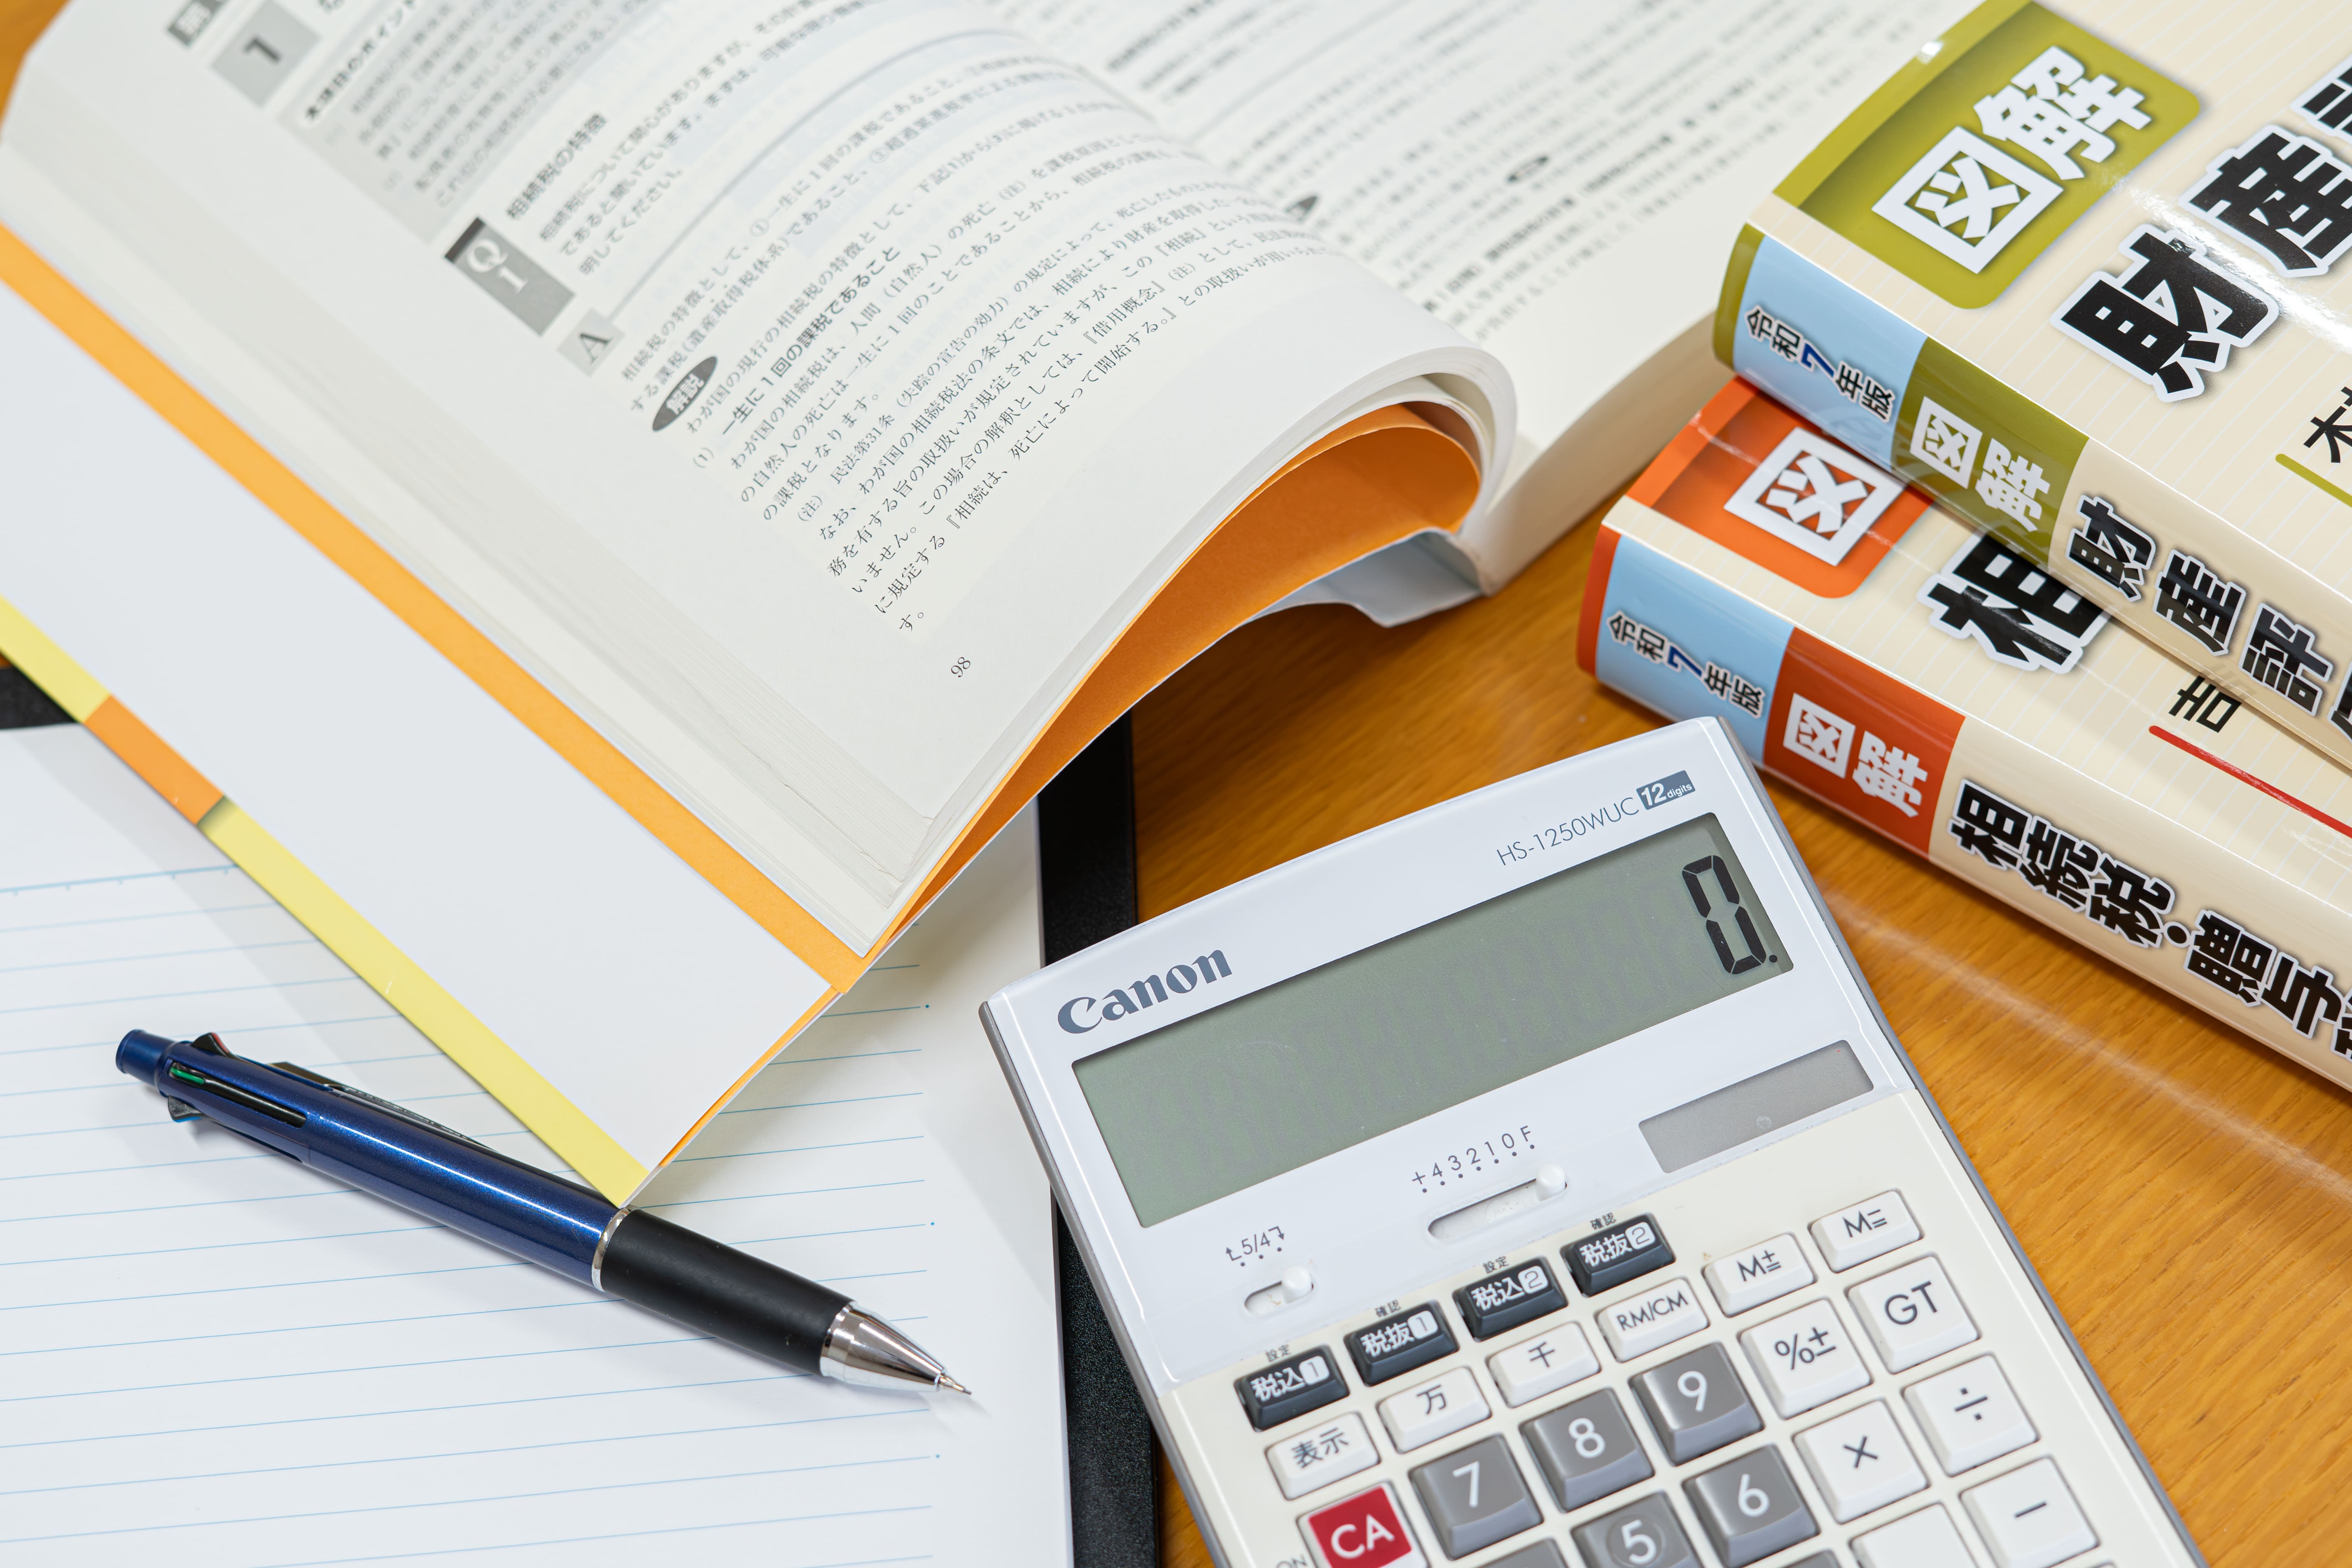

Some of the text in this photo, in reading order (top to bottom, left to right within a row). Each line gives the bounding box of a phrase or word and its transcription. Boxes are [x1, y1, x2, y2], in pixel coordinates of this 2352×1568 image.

[1871, 46, 2151, 273] 図解
[2059, 56, 2352, 394] 財産
[579, 330, 613, 365] A
[2303, 386, 2352, 463] 木
[759, 387, 884, 523] の課税となります。
[1746, 306, 2352, 741] 令和7年版 図解 財産評
[899, 609, 924, 633] す。
[950, 656, 971, 678] 98
[1496, 797, 1639, 866] HS-1250WUC
[1608, 611, 2352, 1061] 令和7年版 図解 相続税・贈与
[1058, 950, 1233, 1034] Canon
[1590, 1212, 1617, 1230] 確認
[1483, 1255, 1509, 1274] 設定
[1375, 1300, 1401, 1318] 確認
[1617, 1290, 1689, 1331] RM/CM
[1884, 1281, 1939, 1325] GT
[1265, 1344, 1291, 1362] 設定
[1528, 1341, 1556, 1368] 千
[1416, 1384, 1447, 1415] 万
[1677, 1370, 1708, 1412] 9
[1292, 1427, 1348, 1468] 表示
[1568, 1418, 1605, 1458] 8
[1452, 1461, 1480, 1508] 7
[1737, 1473, 1770, 1517] 6
[1331, 1514, 1395, 1559] CA
[1621, 1520, 1657, 1564] 5
